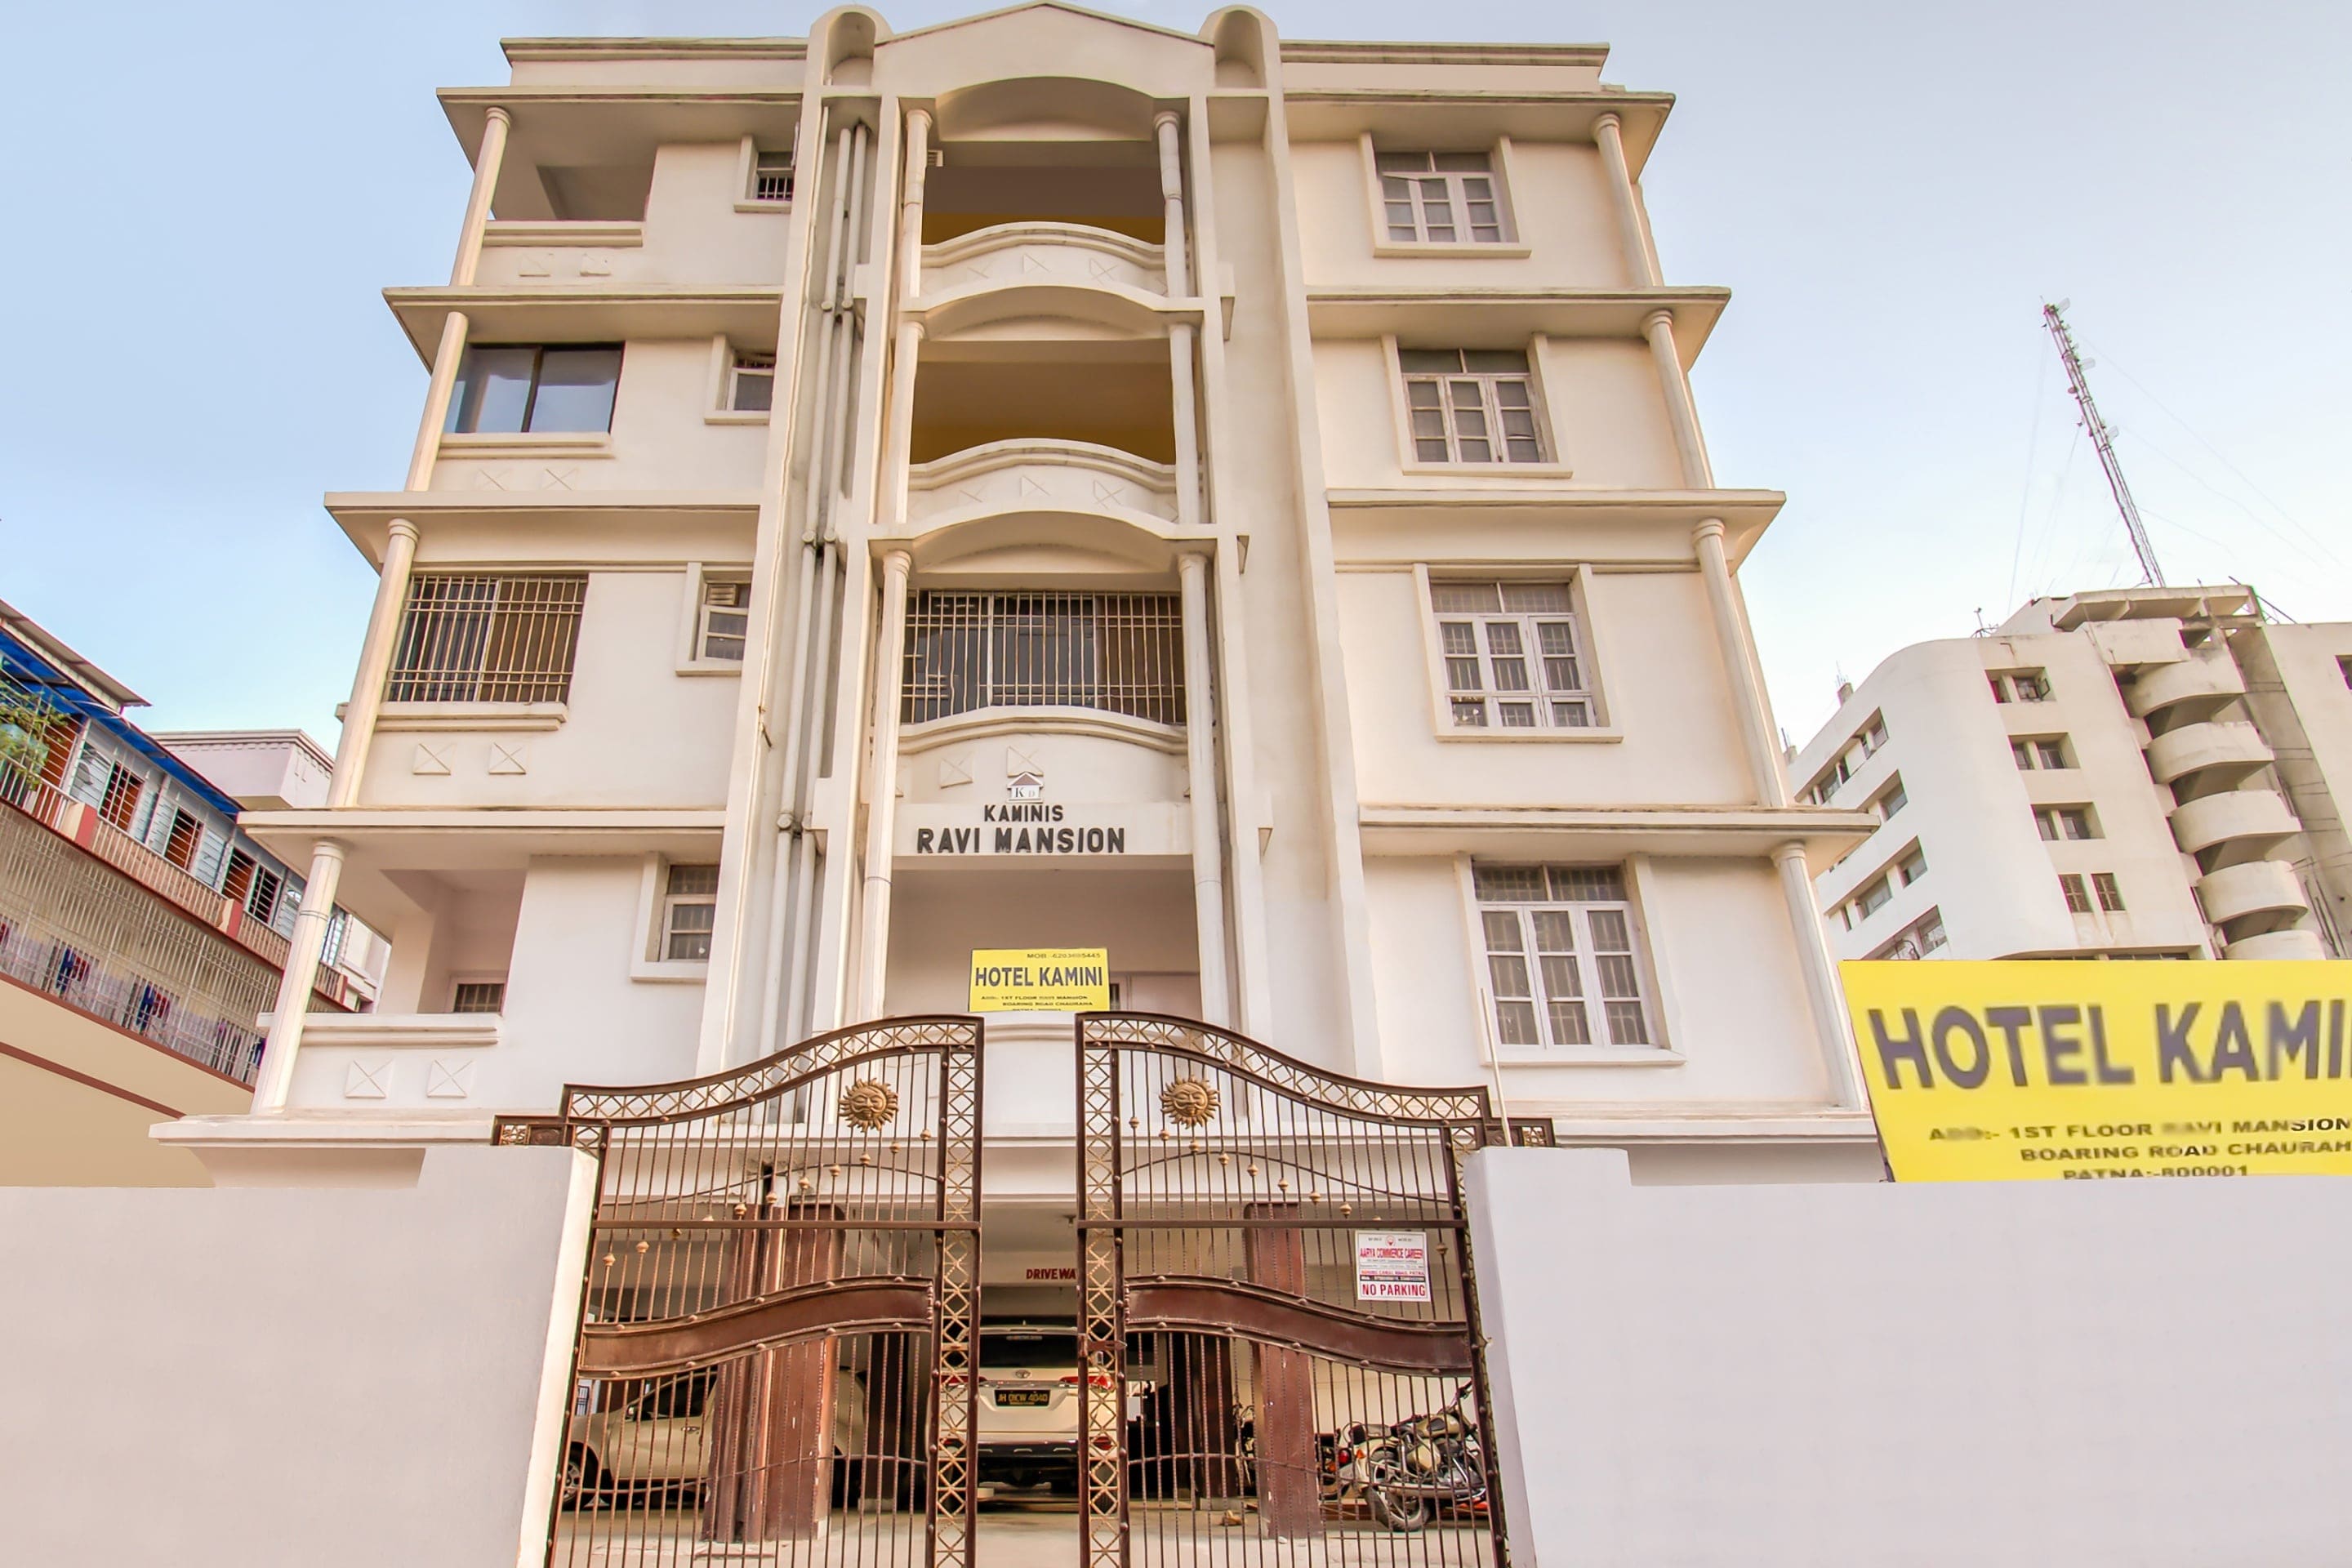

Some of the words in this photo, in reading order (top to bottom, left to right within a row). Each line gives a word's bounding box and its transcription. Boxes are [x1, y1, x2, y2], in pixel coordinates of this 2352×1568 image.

[983, 804, 1064, 822] KAMINIS
[916, 827, 980, 853] RAVI
[995, 827, 1125, 853] MANSION
[975, 966, 1034, 987] HOTEL
[1040, 966, 1102, 987] KAMINI
[1867, 1004, 2136, 1090] HOTEL
[2154, 998, 2352, 1085] KAMI
[2010, 1125, 2057, 1139] 1ST
[2067, 1123, 2153, 1138] FLOOR
[2233, 1117, 2351, 1134] MANSION
[2020, 1145, 2139, 1161] BOARING
[2149, 1143, 2217, 1158] ROAD
[2227, 1140, 2352, 1155] CHAURAH
[1026, 1267, 1076, 1280] DRIVEWA
[1362, 1284, 1377, 1296] NO
[1380, 1284, 1426, 1297] PARKING
